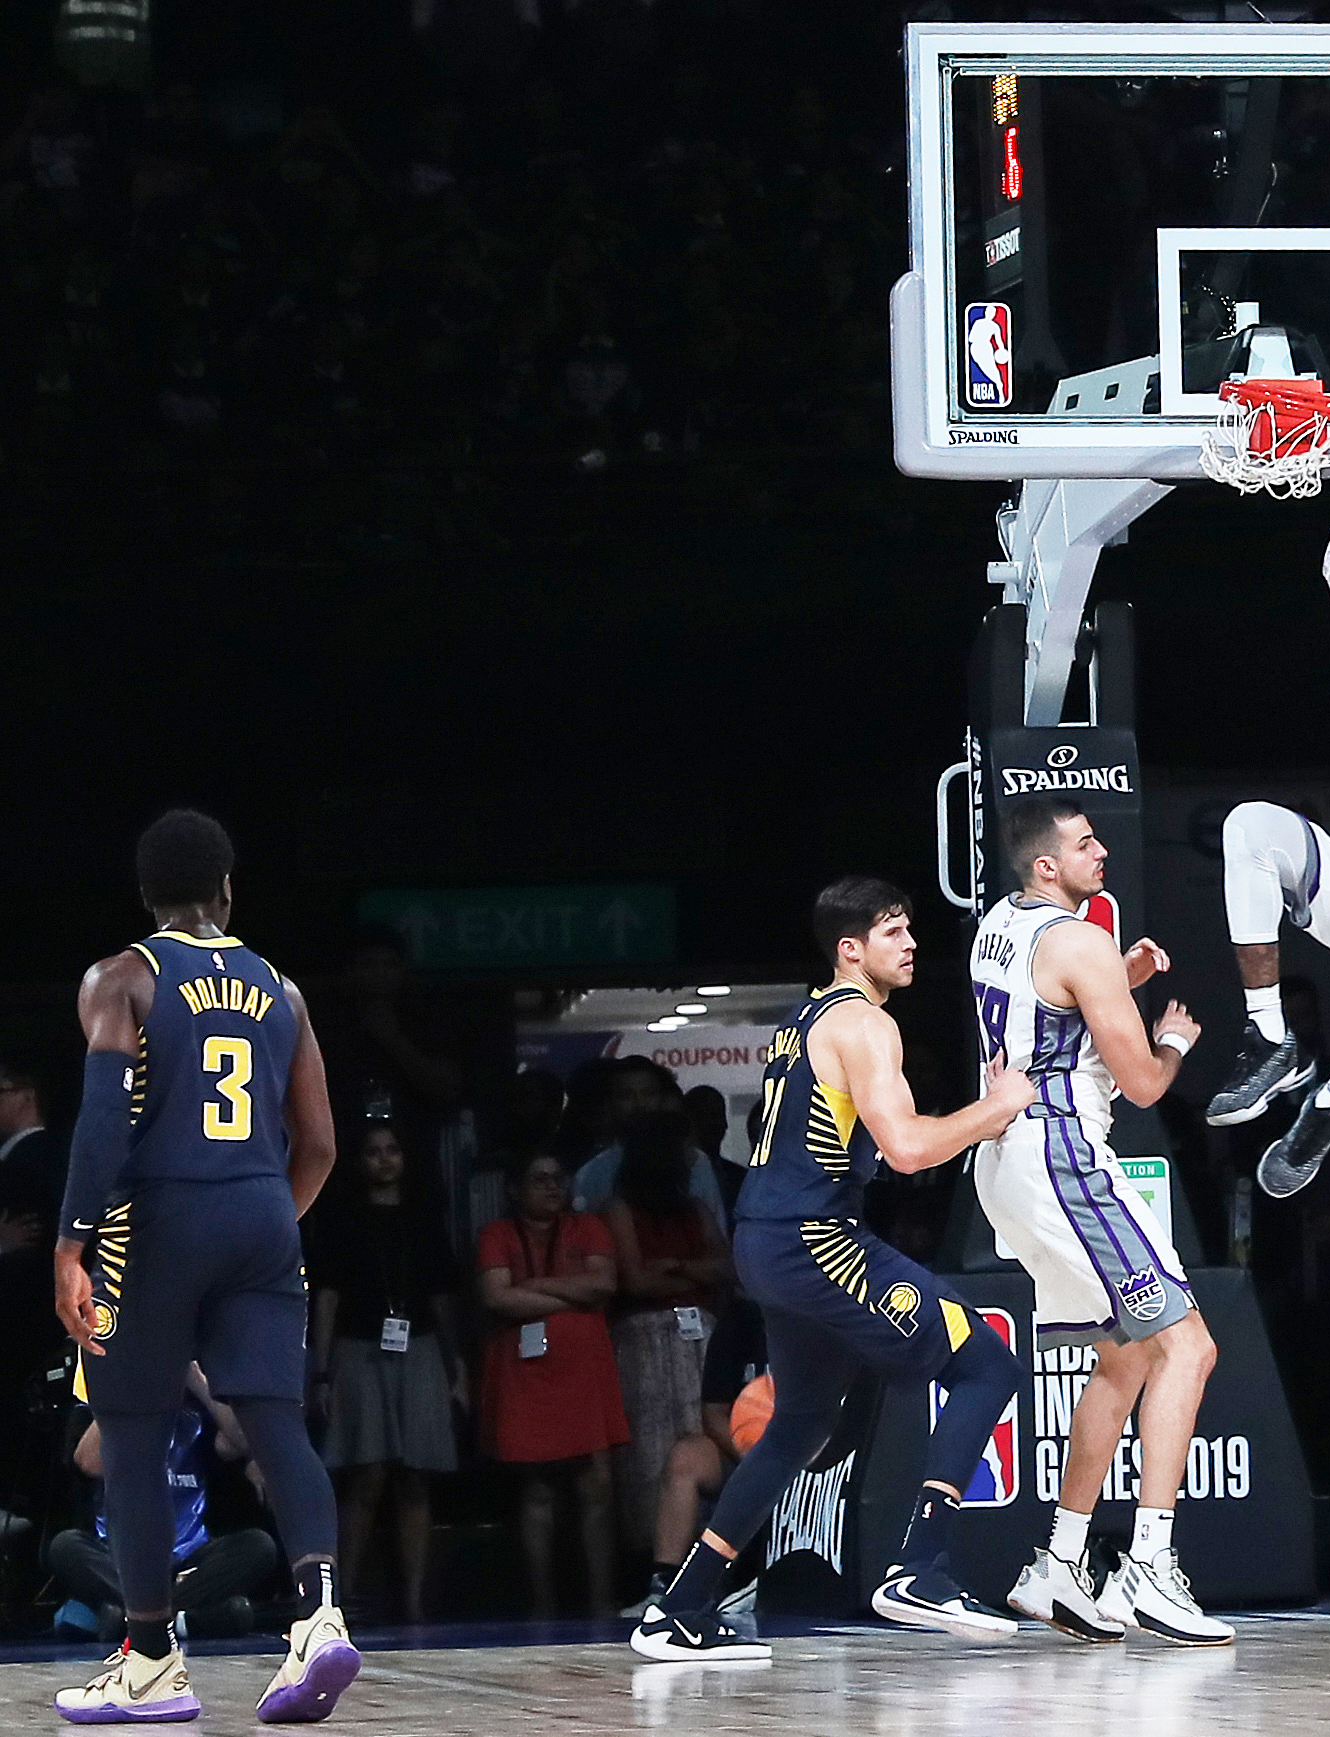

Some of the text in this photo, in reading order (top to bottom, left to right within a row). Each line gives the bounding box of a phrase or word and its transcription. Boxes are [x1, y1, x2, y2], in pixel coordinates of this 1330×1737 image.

[972, 383, 996, 401] NBA
[948, 430, 1019, 445] SPALDING
[1002, 765, 1129, 796] SPALDING
[178, 975, 275, 1023] HOLIDAY
[652, 1048, 750, 1068] COUPON
[202, 1035, 253, 1142] 3
[1126, 1164, 1156, 1177] TION
[1124, 1283, 1162, 1308] SAC
